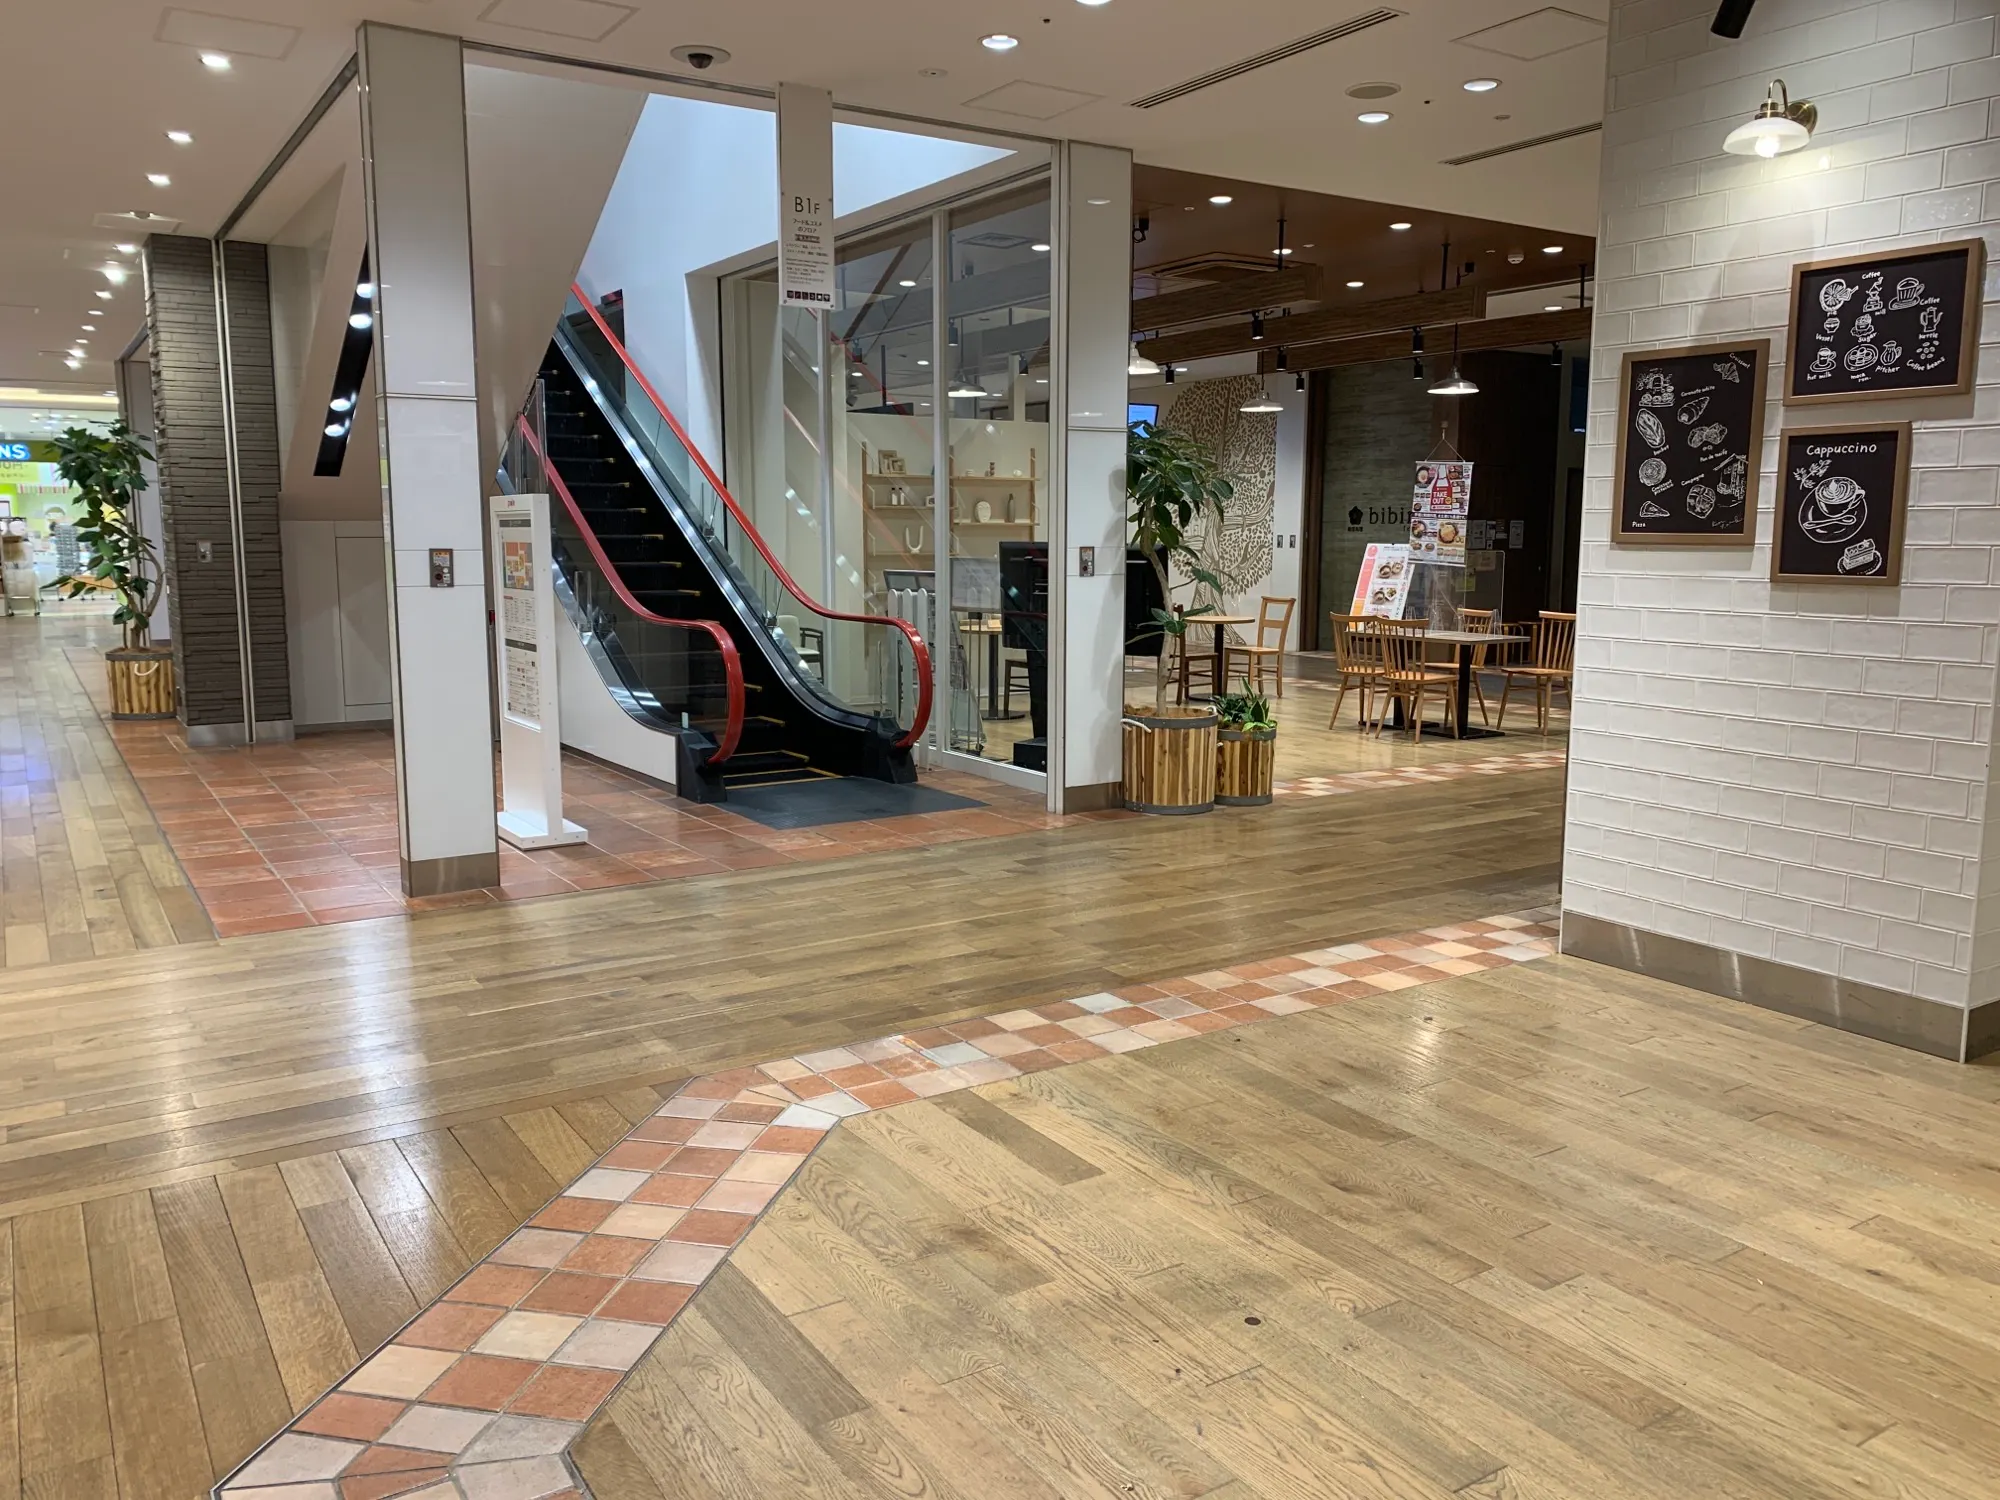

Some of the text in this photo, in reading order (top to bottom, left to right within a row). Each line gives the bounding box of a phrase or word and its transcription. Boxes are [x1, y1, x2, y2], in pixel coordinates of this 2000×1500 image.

[795, 196, 820, 214] B1F
[1862, 271, 1881, 279] Coffee
[1920, 297, 1940, 305] Coffee
[1874, 365, 1900, 373] pitcher
[1906, 359, 1926, 371] Coffee
[1807, 373, 1817, 381] hot
[1806, 442, 1878, 458] Cappuccino
